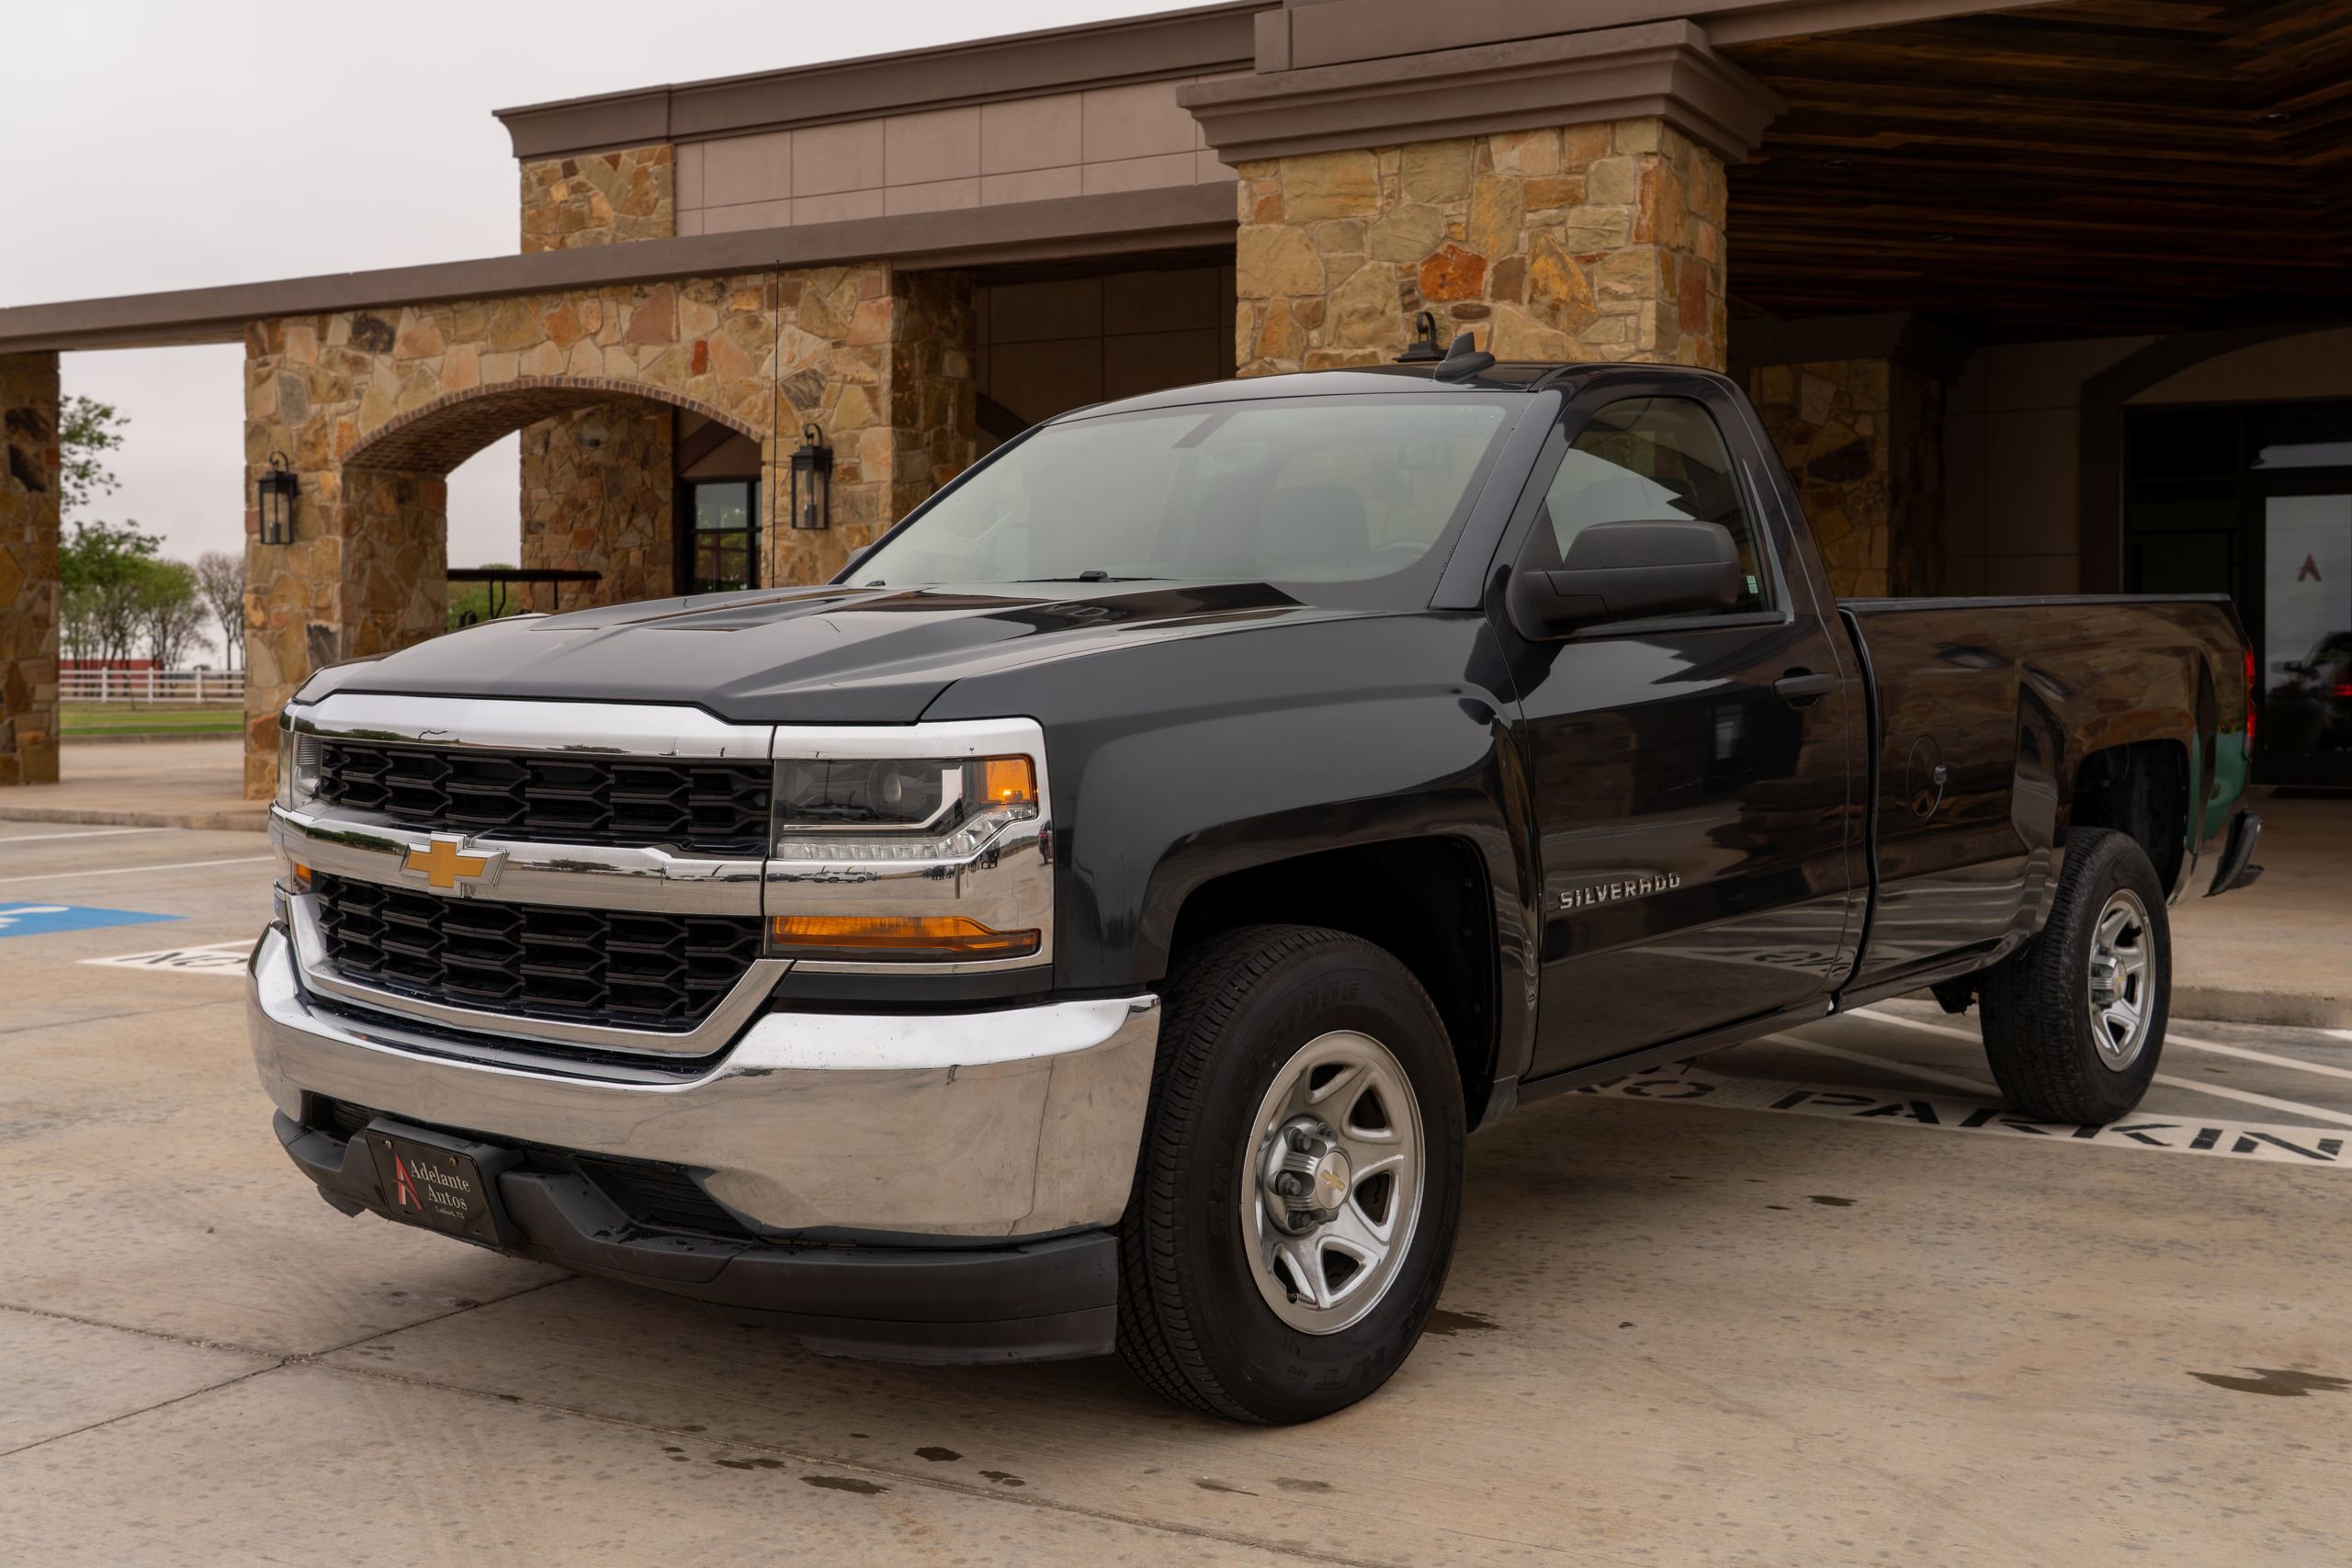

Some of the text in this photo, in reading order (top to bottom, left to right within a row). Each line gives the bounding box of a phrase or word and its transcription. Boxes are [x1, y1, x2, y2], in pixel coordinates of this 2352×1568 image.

[1559, 872, 1680, 909] SILVERADO
[411, 1158, 470, 1192] Adelante
[427, 1183, 468, 1211] Autos
